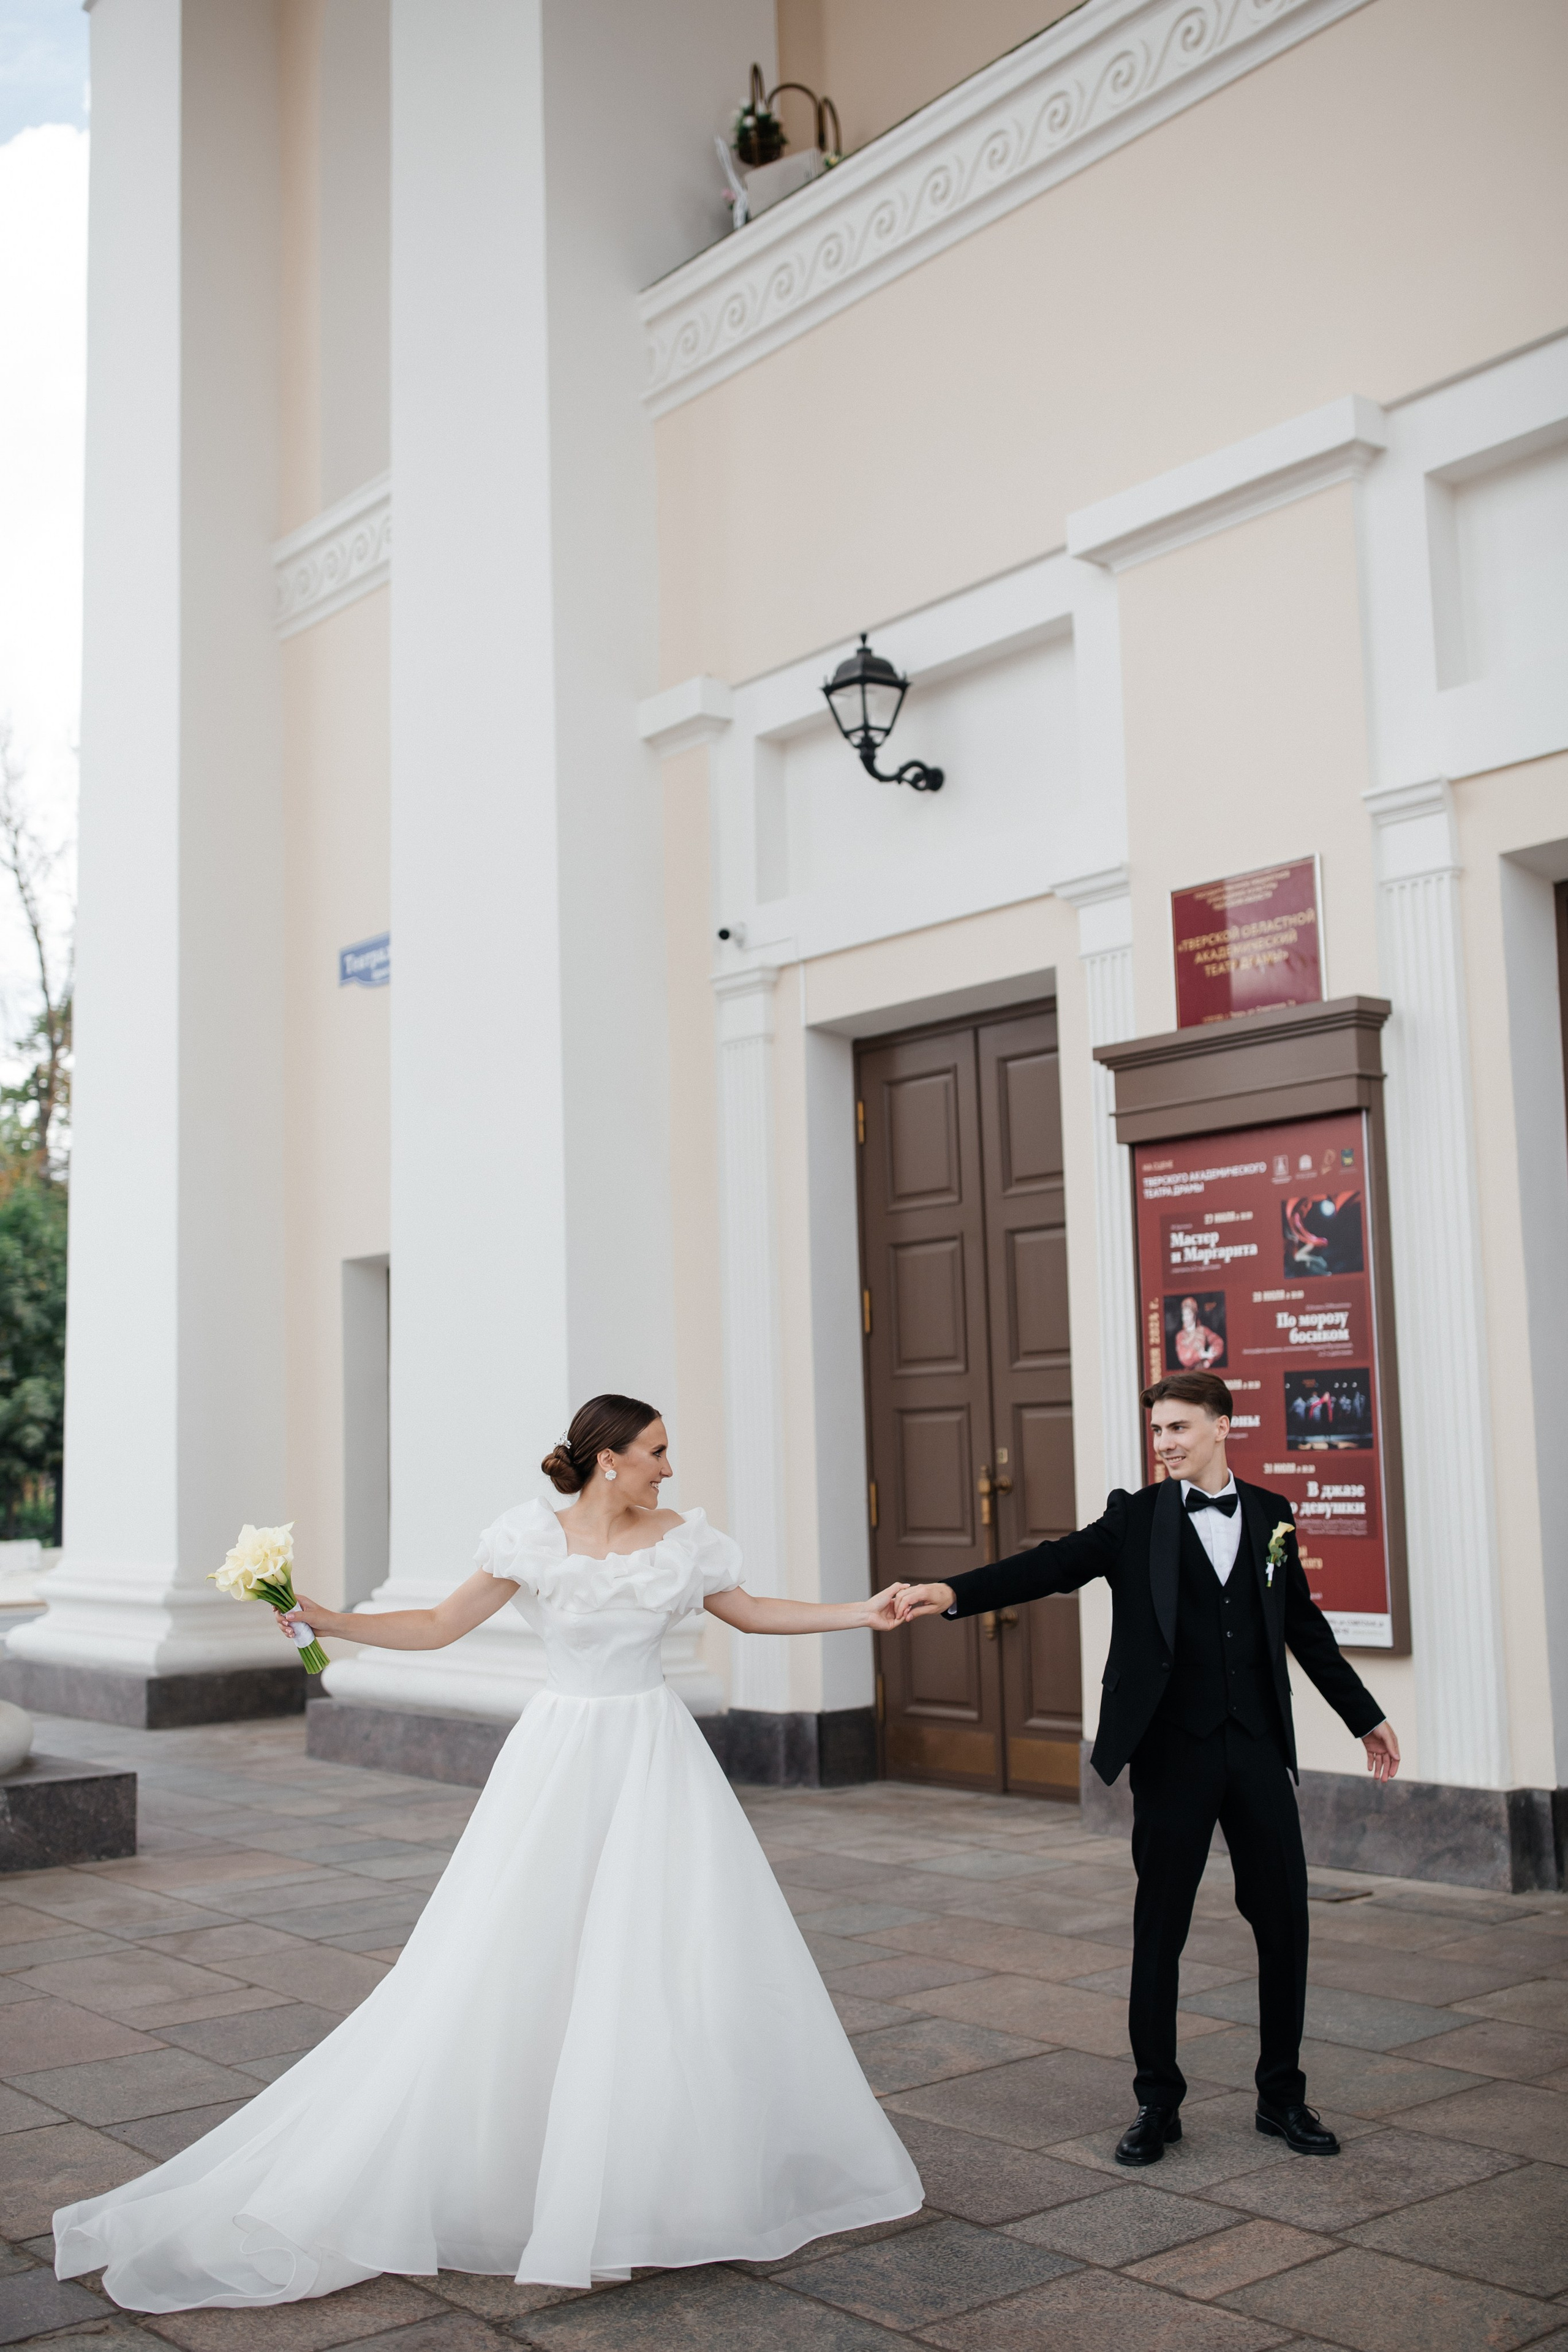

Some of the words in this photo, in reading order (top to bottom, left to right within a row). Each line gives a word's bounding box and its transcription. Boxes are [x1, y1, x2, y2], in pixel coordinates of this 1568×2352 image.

[1194, 927, 1298, 965] АКАДЕМИЧЕСКИЙ
[1204, 958, 1240, 978] ТЕАТР
[1143, 1172, 1188, 1188] ТВЕРСКОГО
[1189, 1161, 1267, 1183] АКАДЕМИЧЕСКОГО
[1143, 1186, 1172, 1199] ТЕАТРА
[1172, 1181, 1204, 1197] ДРАМЫ
[1170, 1231, 1219, 1248] Мастер
[1170, 1251, 1182, 1264] и
[1183, 1243, 1258, 1265] Маргарита
[1276, 1311, 1297, 1329] По
[1298, 1311, 1349, 1330] морозу
[1289, 1327, 1350, 1344] босиком
[1306, 1480, 1319, 1498] В
[1320, 1484, 1365, 1500] джазе
[1299, 1502, 1366, 1520] девушки
